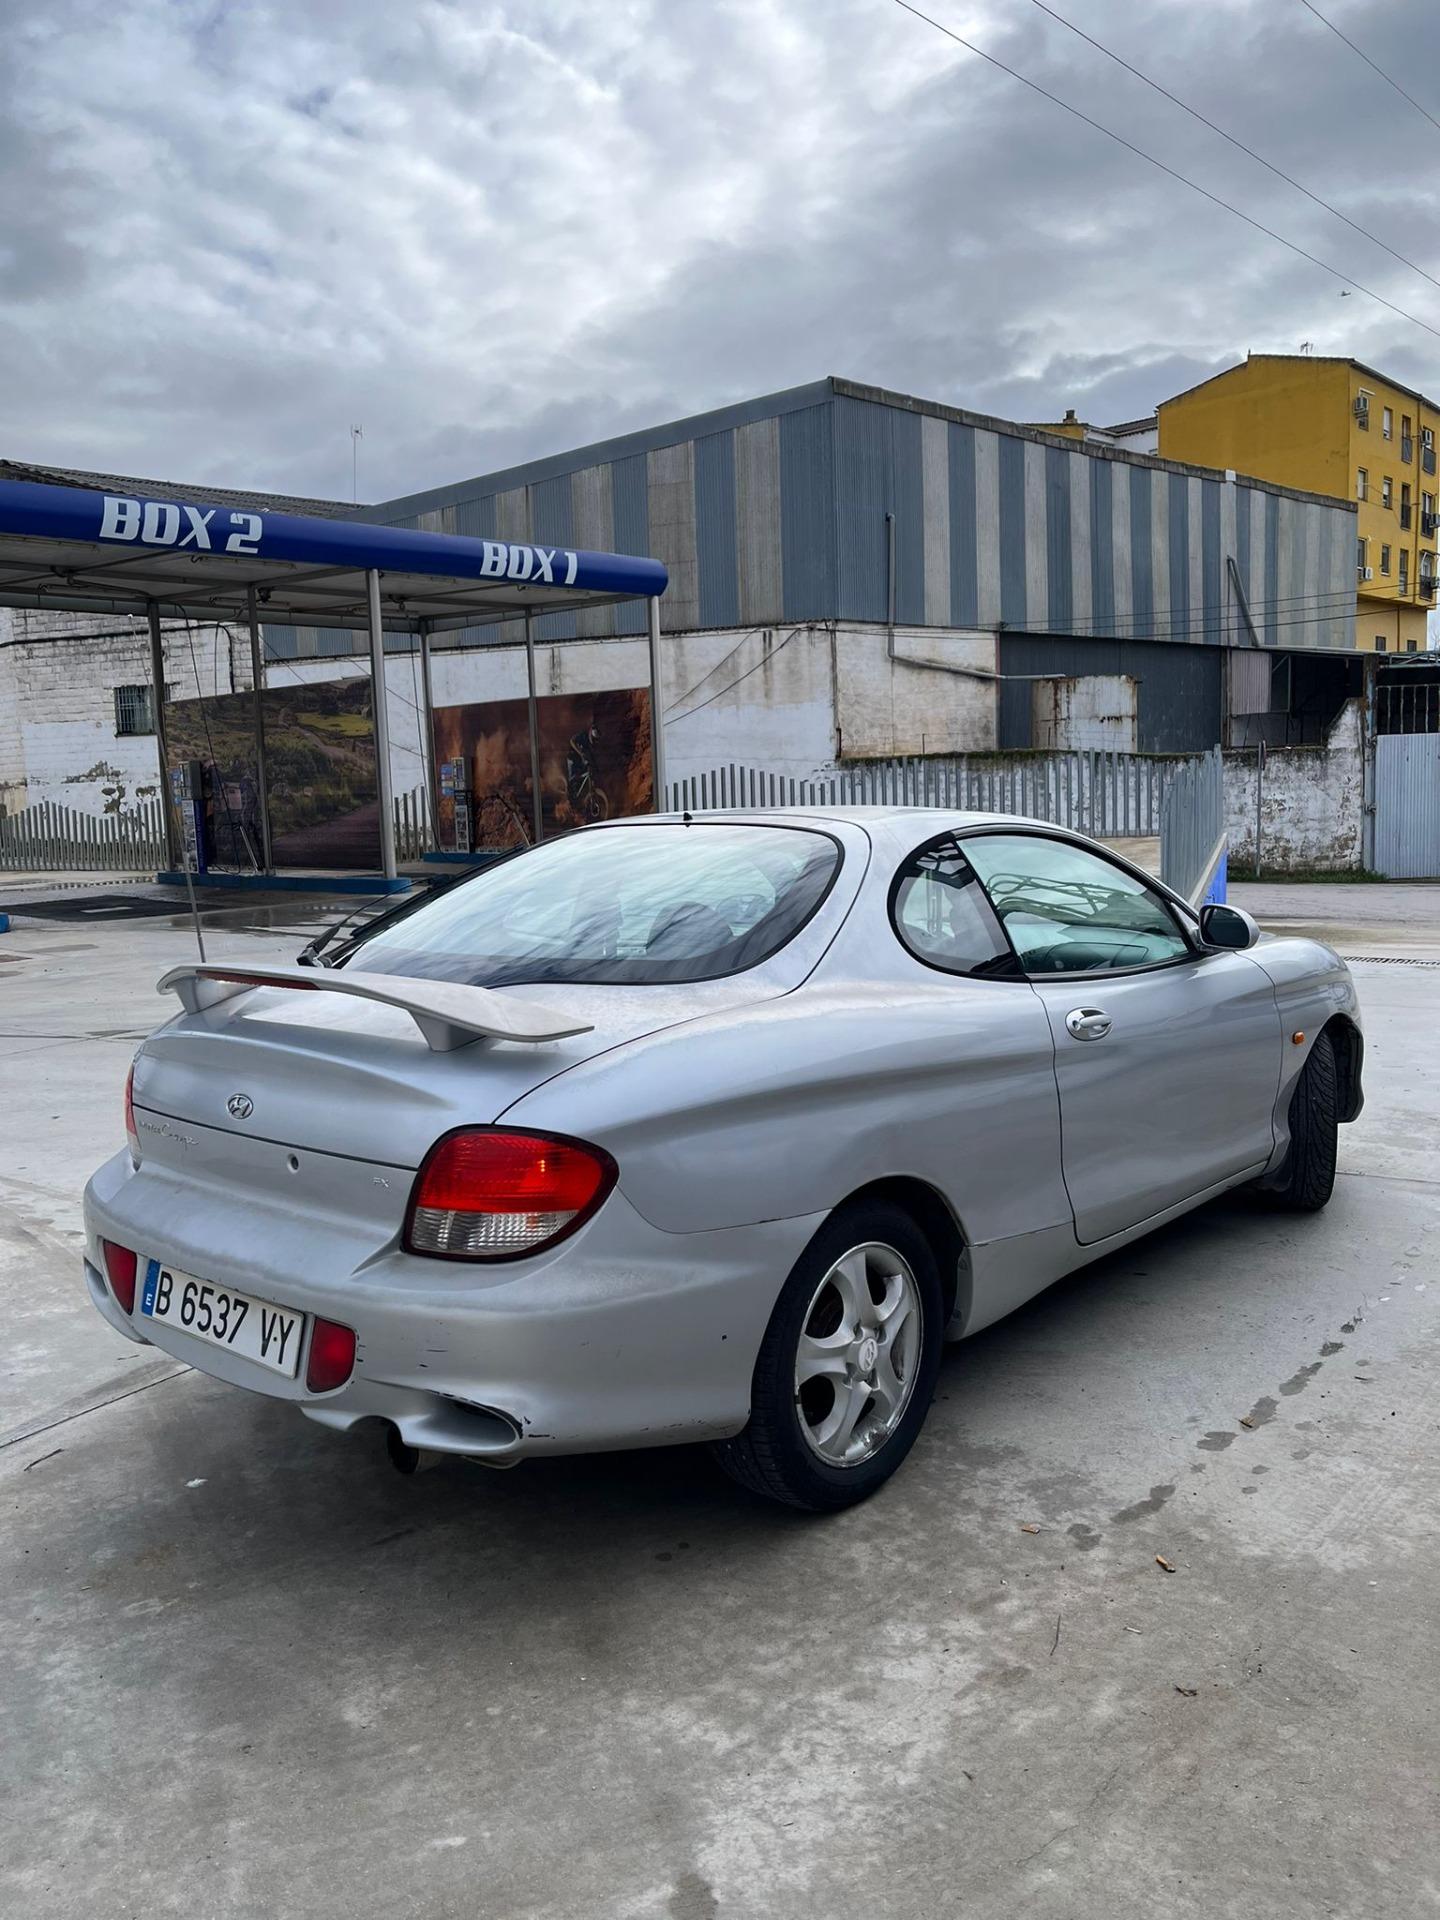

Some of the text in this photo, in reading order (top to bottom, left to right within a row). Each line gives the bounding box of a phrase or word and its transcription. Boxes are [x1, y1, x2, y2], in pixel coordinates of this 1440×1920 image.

[99, 496, 263, 554] BOX 2
[480, 541, 578, 585] BOX 1
[145, 1293, 153, 1306] E
[155, 1270, 173, 1316] B
[180, 1281, 250, 1344] 6537
